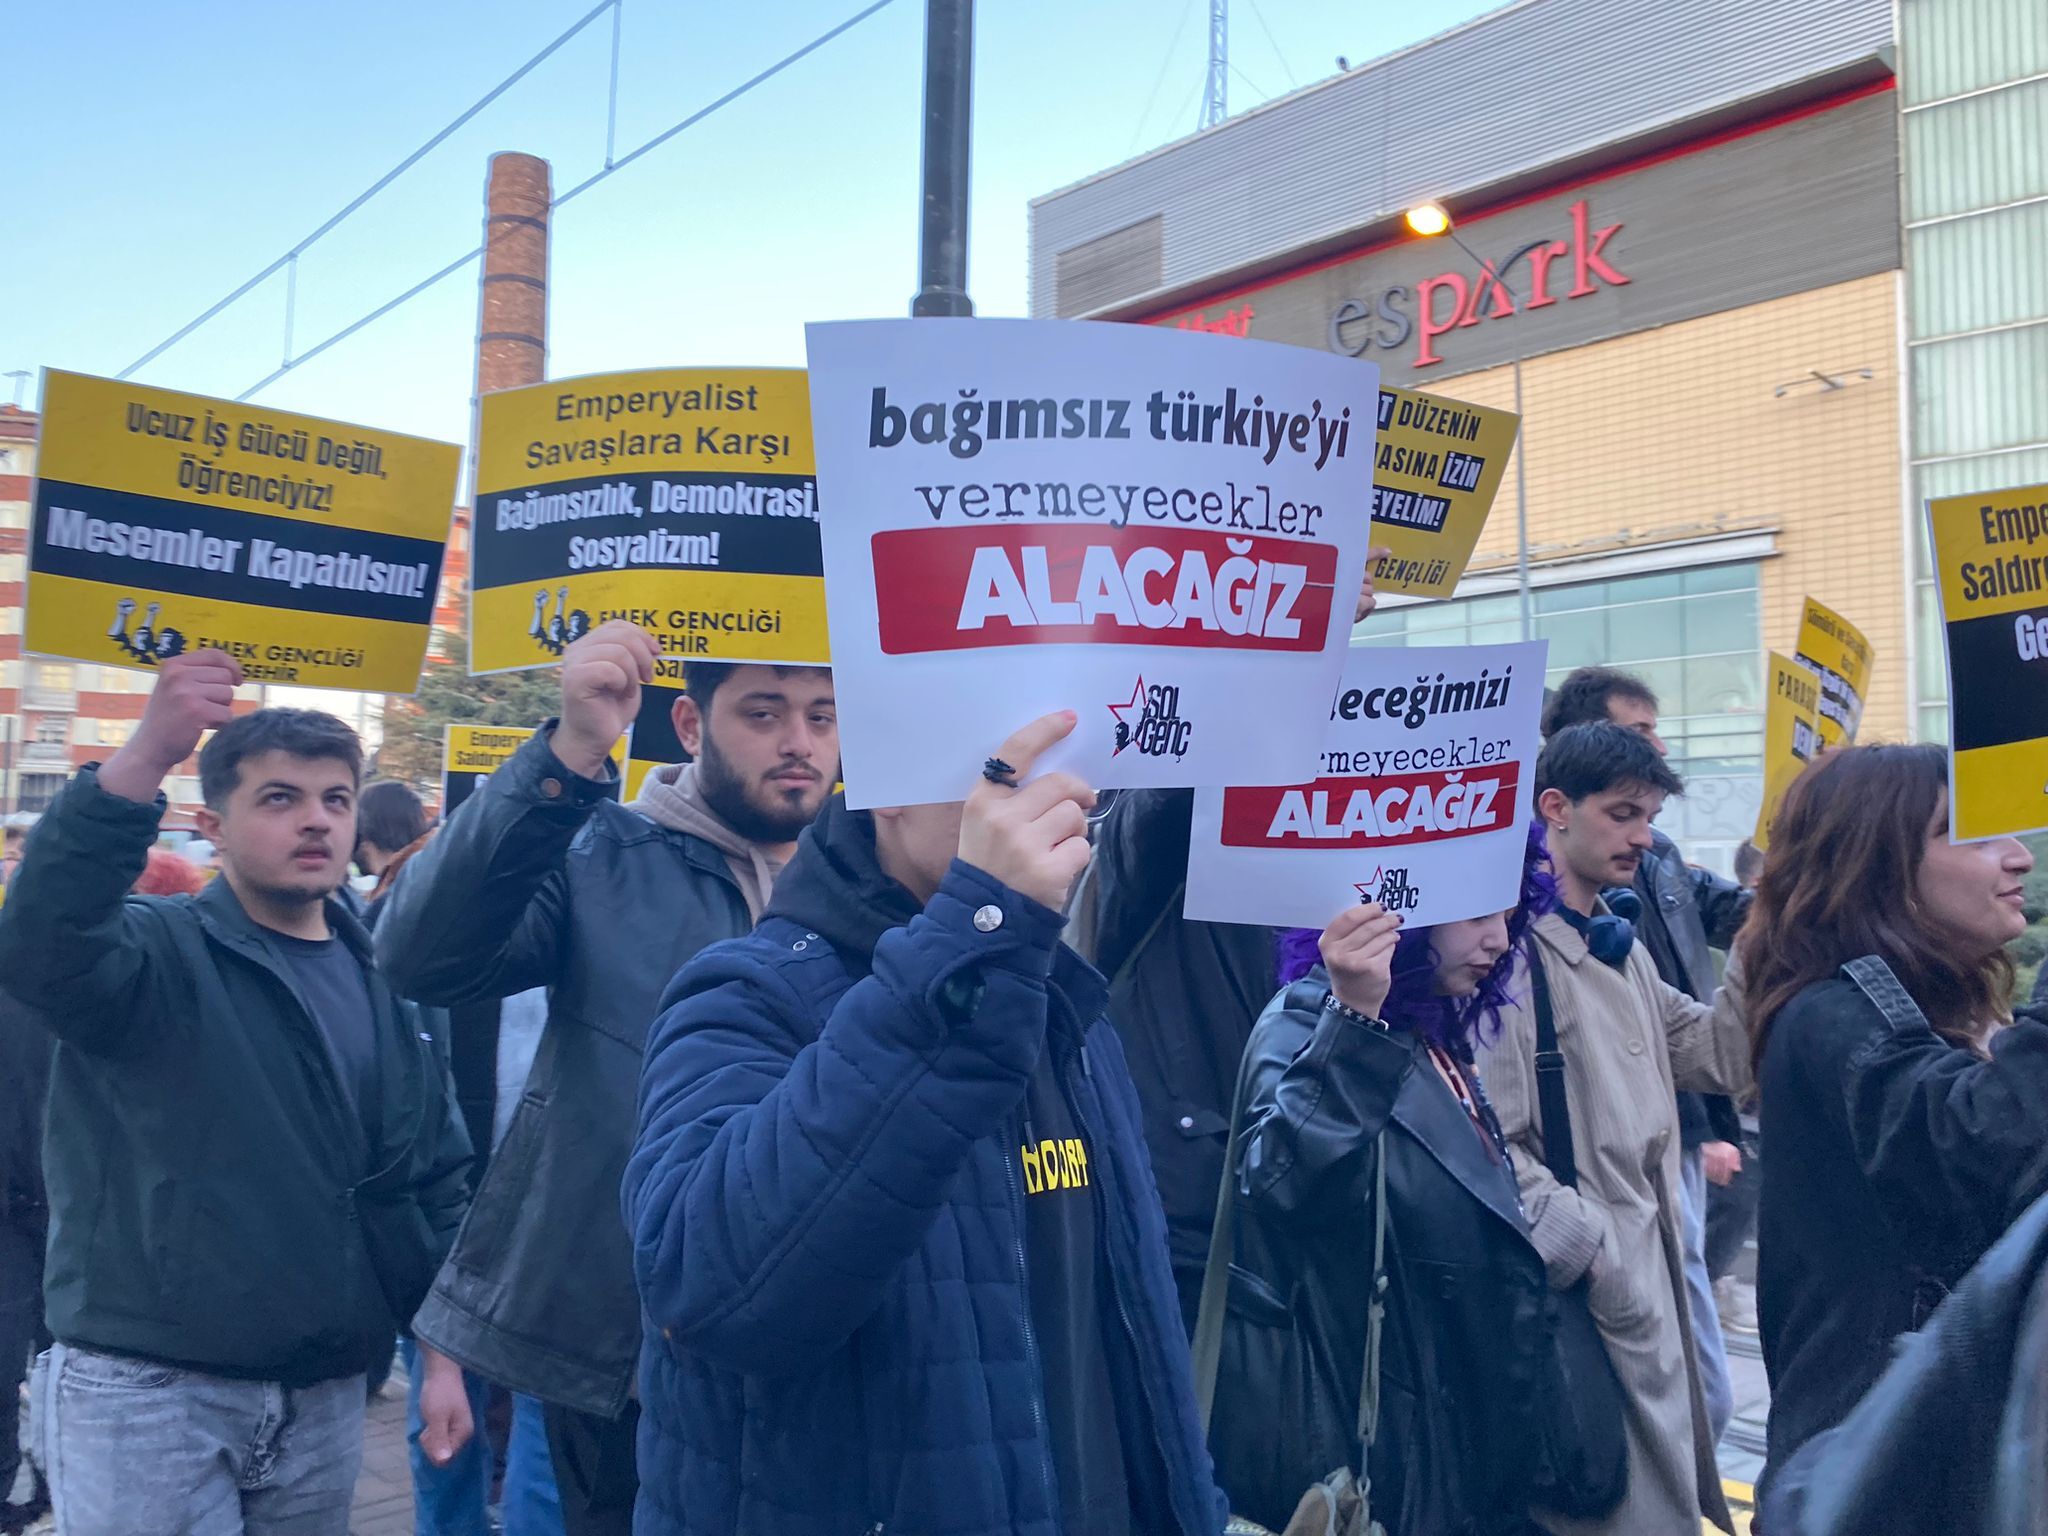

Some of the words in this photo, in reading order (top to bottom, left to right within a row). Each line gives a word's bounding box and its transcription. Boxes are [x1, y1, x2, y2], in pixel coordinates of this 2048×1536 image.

[556, 384, 759, 423] Emperyalist
[869, 387, 1131, 459] bağımsız
[1398, 397, 1482, 442] DÜZENİN
[127, 402, 195, 444] Ucuz
[202, 408, 228, 457] İş
[239, 419, 309, 463] Gücü
[317, 437, 386, 479] Değil,
[526, 430, 682, 469] Savaşlara
[696, 427, 790, 463] Karşı
[178, 452, 333, 513] Öğrenciyiz!
[1375, 442, 1440, 480] ASINA
[1441, 451, 1482, 489] İZİN
[496, 480, 643, 532] Bağımsızlık,
[651, 480, 820, 524] Demokrasi,
[916, 482, 1323, 538] vermeyecekler
[46, 506, 243, 573] Mesemler
[247, 538, 430, 599] Kapatılsın!
[569, 528, 721, 570] Sosyalizm!
[956, 537, 1307, 640] ALACAĞIZ
[1375, 558, 1451, 589] GENÇLİĞİ
[1961, 555, 2048, 602] Saldır
[668, 608, 781, 636] GENÇLİĞİ
[266, 645, 366, 668] GENÇLİĞİ
[1330, 665, 1512, 729] eceğimizi
[1320, 736, 1511, 779] meyecekler
[1266, 771, 1500, 839] ALACAĞIZ
